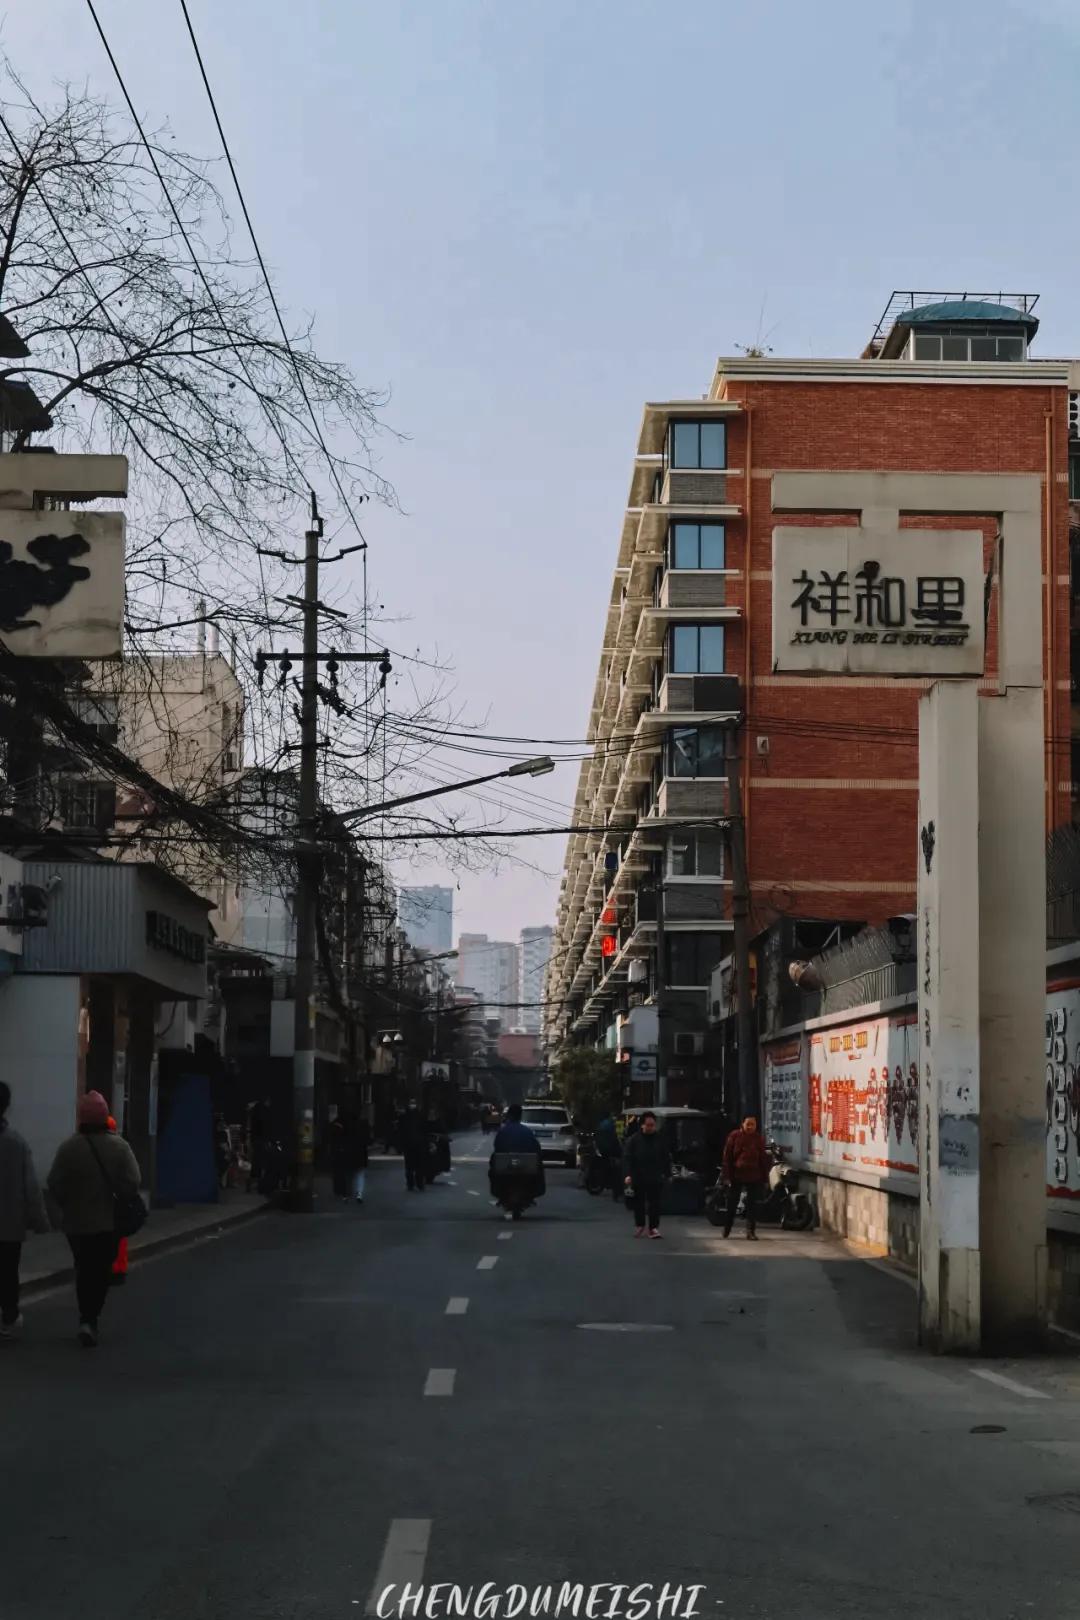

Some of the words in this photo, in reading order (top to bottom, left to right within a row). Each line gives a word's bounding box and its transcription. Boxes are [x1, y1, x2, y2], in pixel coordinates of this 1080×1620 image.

[791, 560, 970, 629] 祥和里
[790, 631, 848, 645] XIANG
[852, 632, 878, 645] HE
[902, 632, 969, 646] STREET
